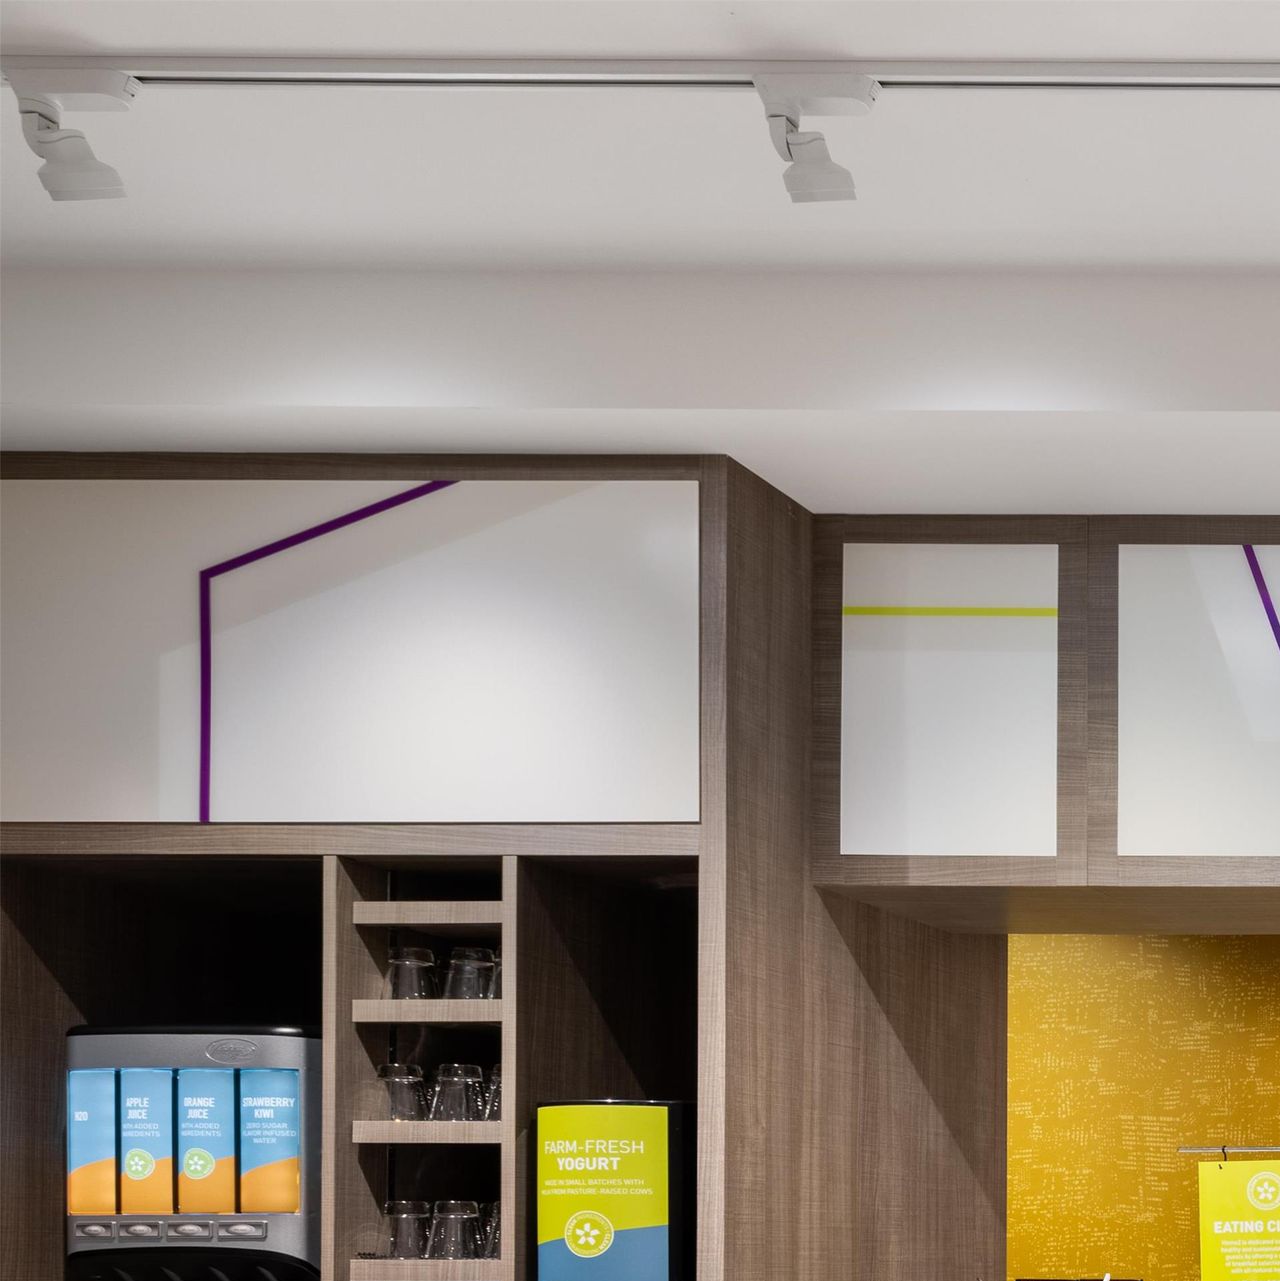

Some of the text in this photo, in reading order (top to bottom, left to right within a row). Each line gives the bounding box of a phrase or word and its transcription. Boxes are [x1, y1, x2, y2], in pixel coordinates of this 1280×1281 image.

[126, 1097, 149, 1107] APPLE
[184, 1097, 215, 1107] ORANGE
[242, 1097, 295, 1107] STRAWBERRY
[127, 1109, 147, 1119] JUICE
[187, 1109, 208, 1119] JUICE
[254, 1109, 273, 1119] KIWI
[544, 1139, 645, 1154] FARM-FRESH
[557, 1157, 621, 1171] YOGURT
[629, 1187, 653, 1195] COWS
[1213, 1220, 1264, 1234] EATING
